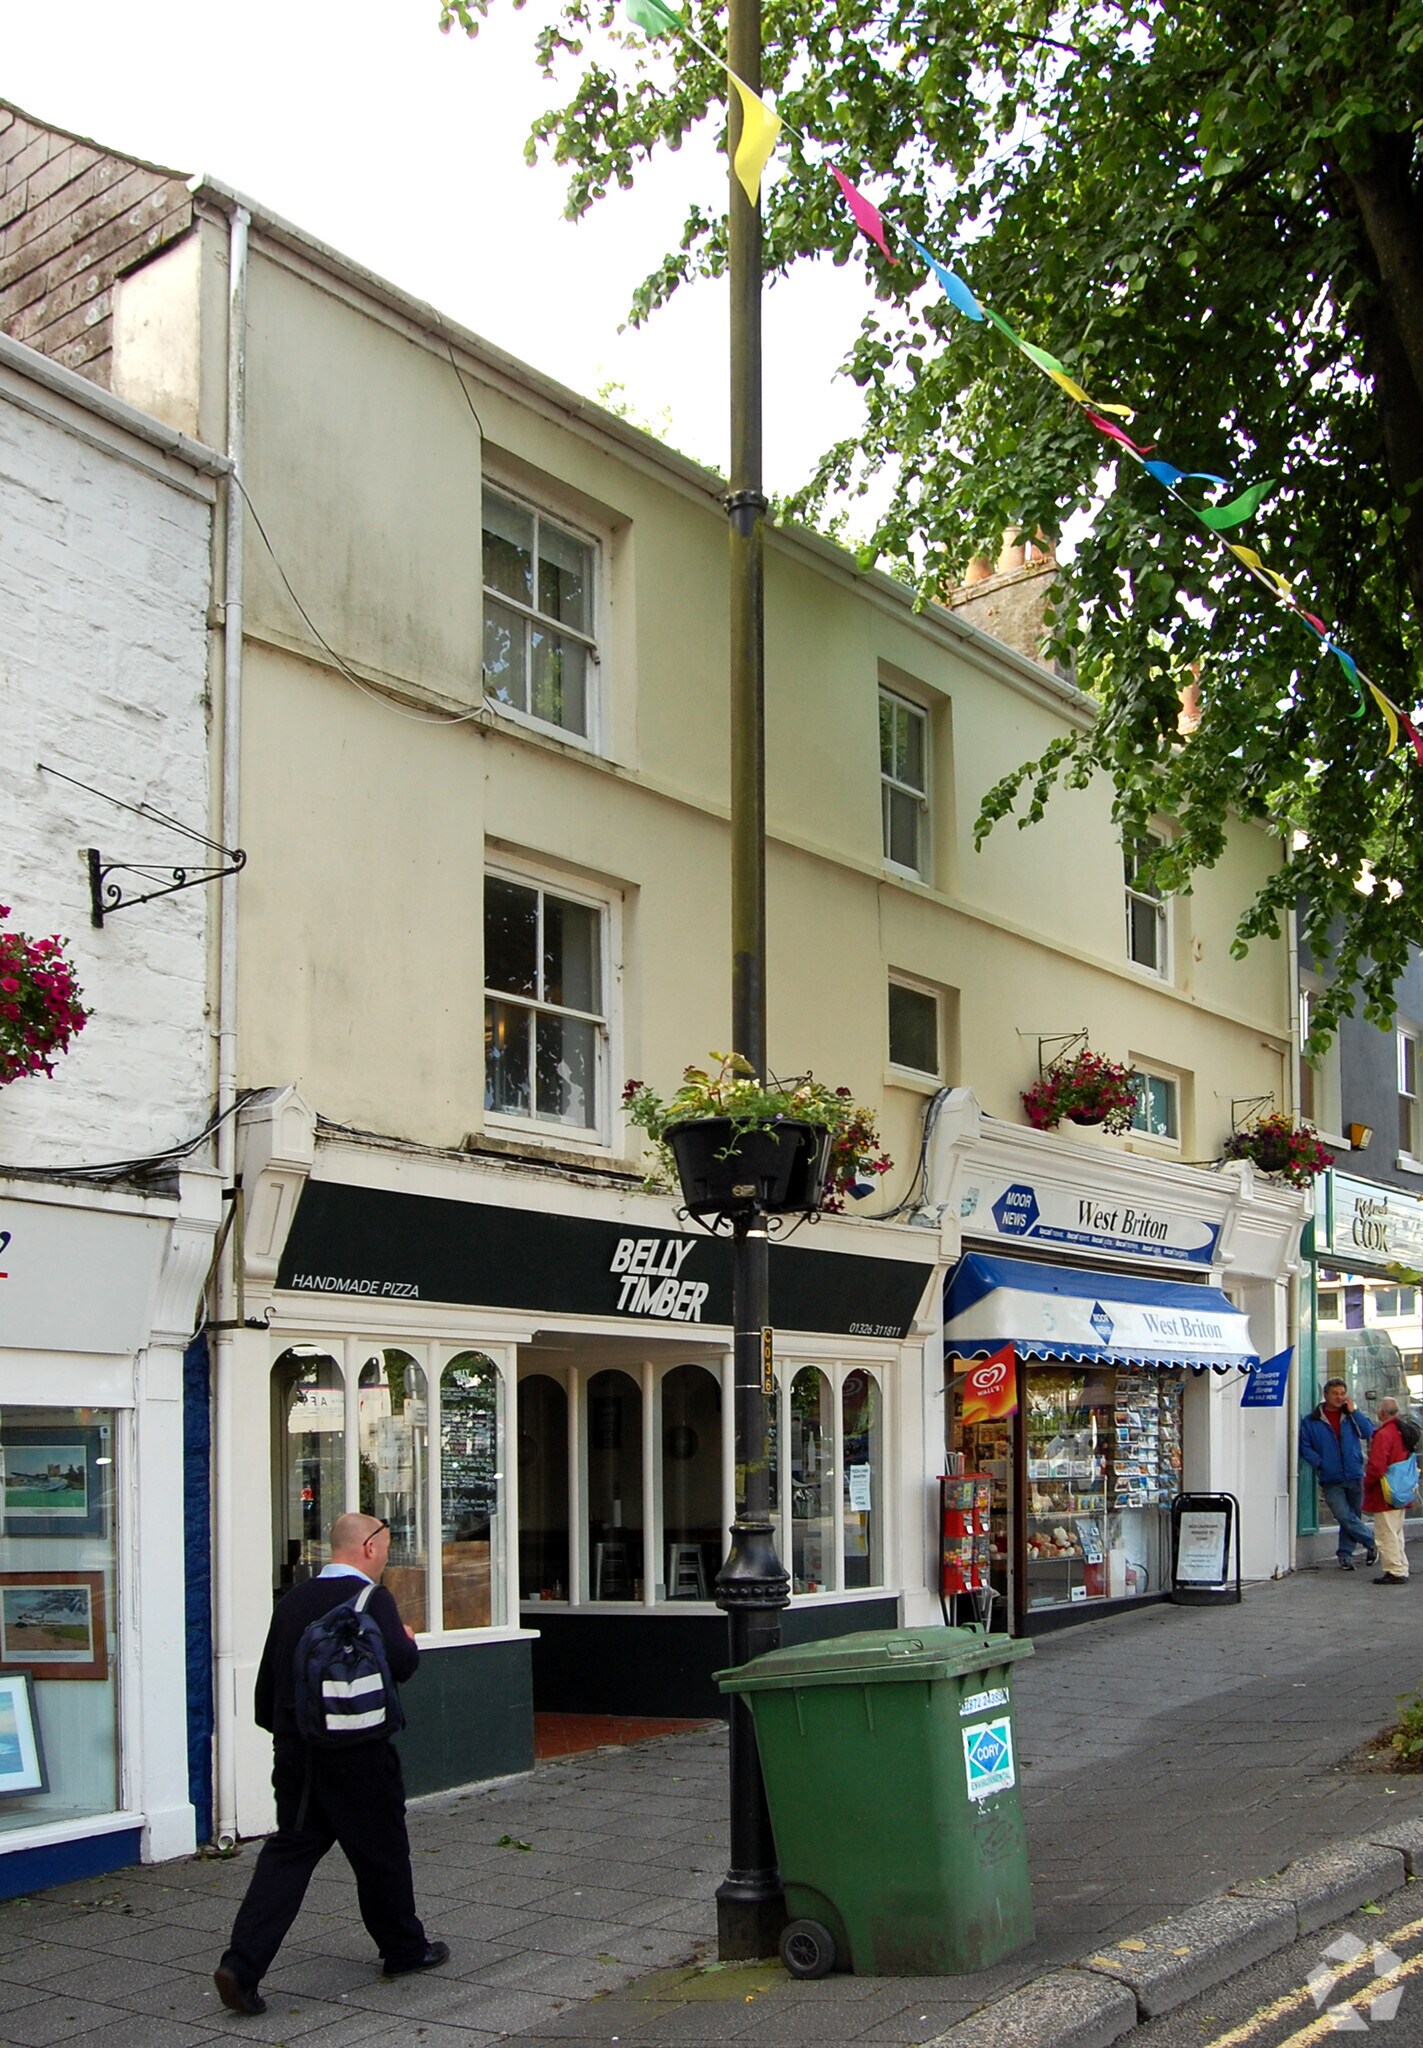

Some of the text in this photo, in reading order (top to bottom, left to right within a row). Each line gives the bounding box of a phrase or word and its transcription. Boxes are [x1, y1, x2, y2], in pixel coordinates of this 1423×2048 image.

[1005, 1191, 1033, 1208] MOOR
[1001, 1211, 1027, 1227] NEWS
[1079, 1200, 1168, 1240] West Briton
[610, 1238, 698, 1278] BELLY
[292, 1274, 419, 1297] HANDMADE PIZZA
[616, 1275, 710, 1323] TIMBER
[849, 1323, 901, 1336] 01326 311811
[1142, 1313, 1223, 1339] West Briton
[763, 1329, 772, 1392] C036
[977, 1744, 999, 1761] CORY
